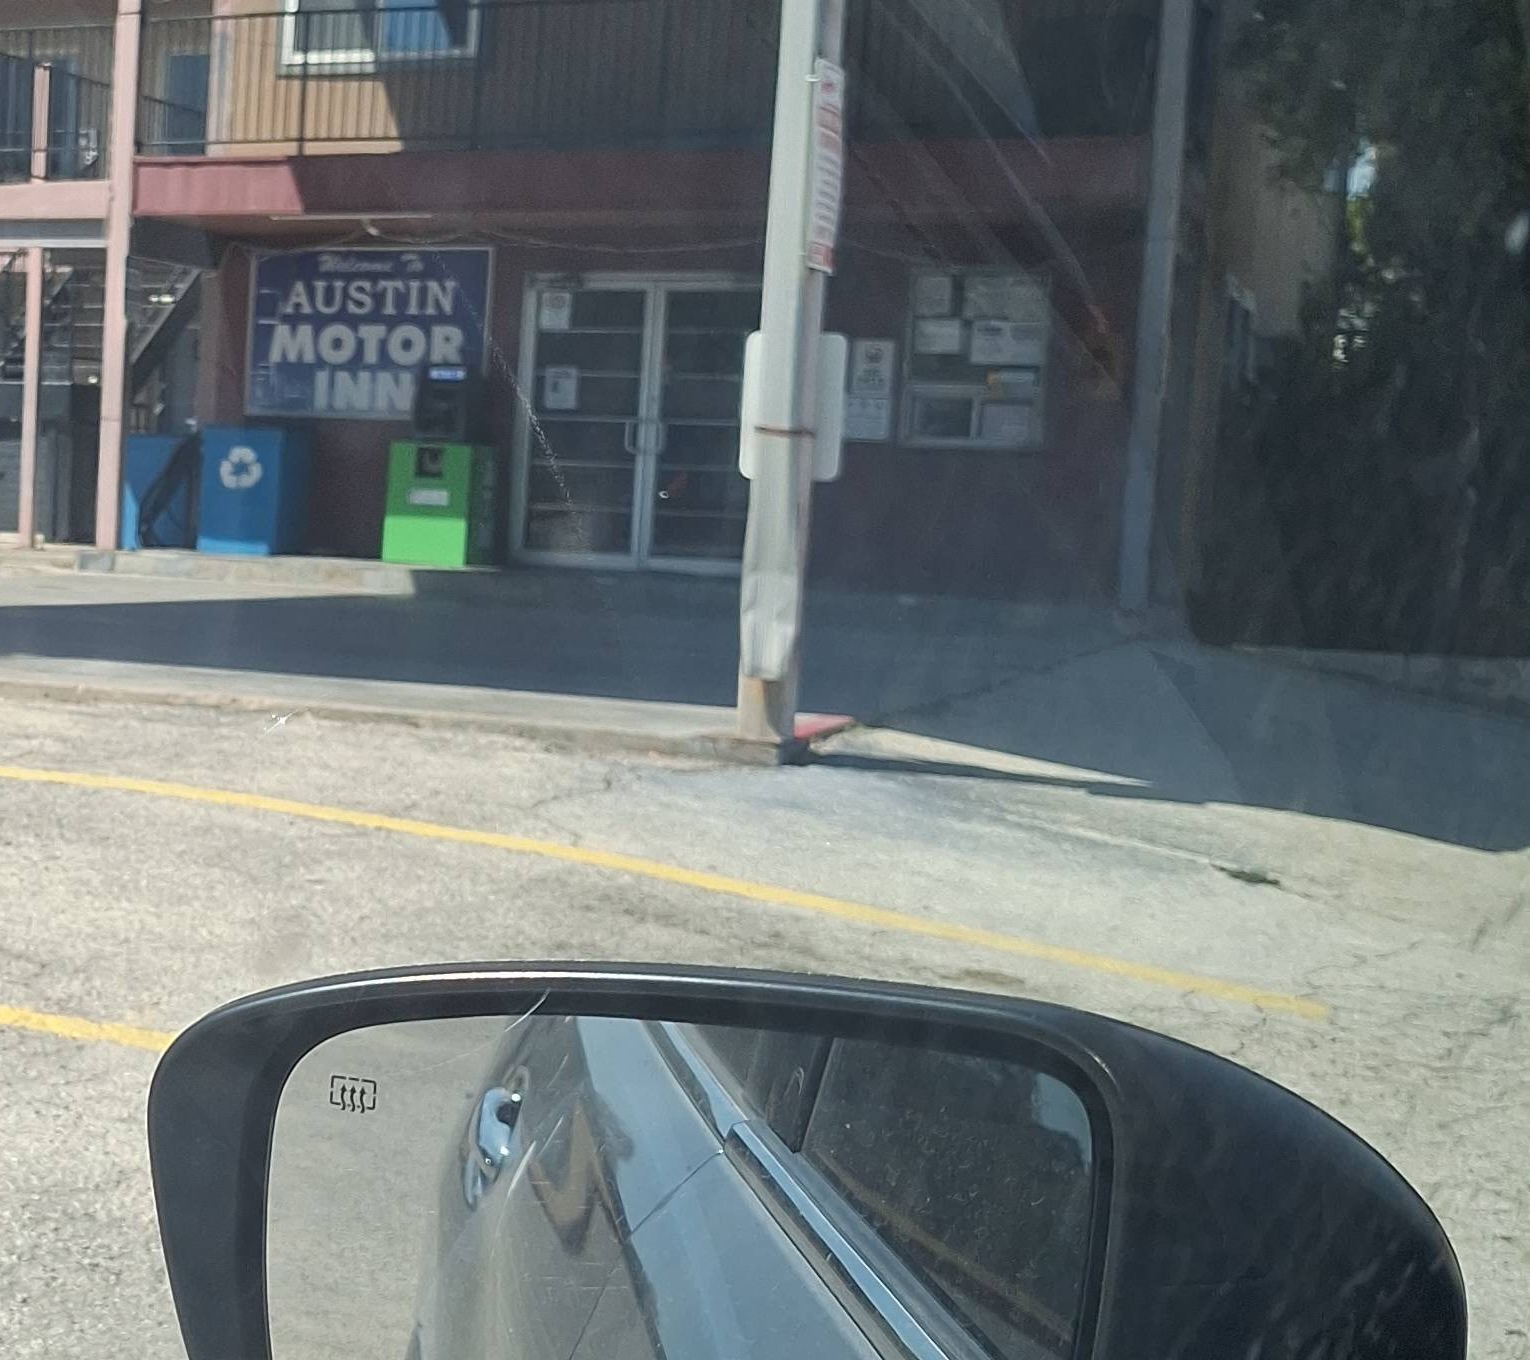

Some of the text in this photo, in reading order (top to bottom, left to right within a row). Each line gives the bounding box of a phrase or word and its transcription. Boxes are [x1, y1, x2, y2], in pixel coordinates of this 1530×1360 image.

[282, 280, 458, 316] AUSTIN
[269, 323, 465, 366] MOTOR
[313, 367, 417, 412] INN
